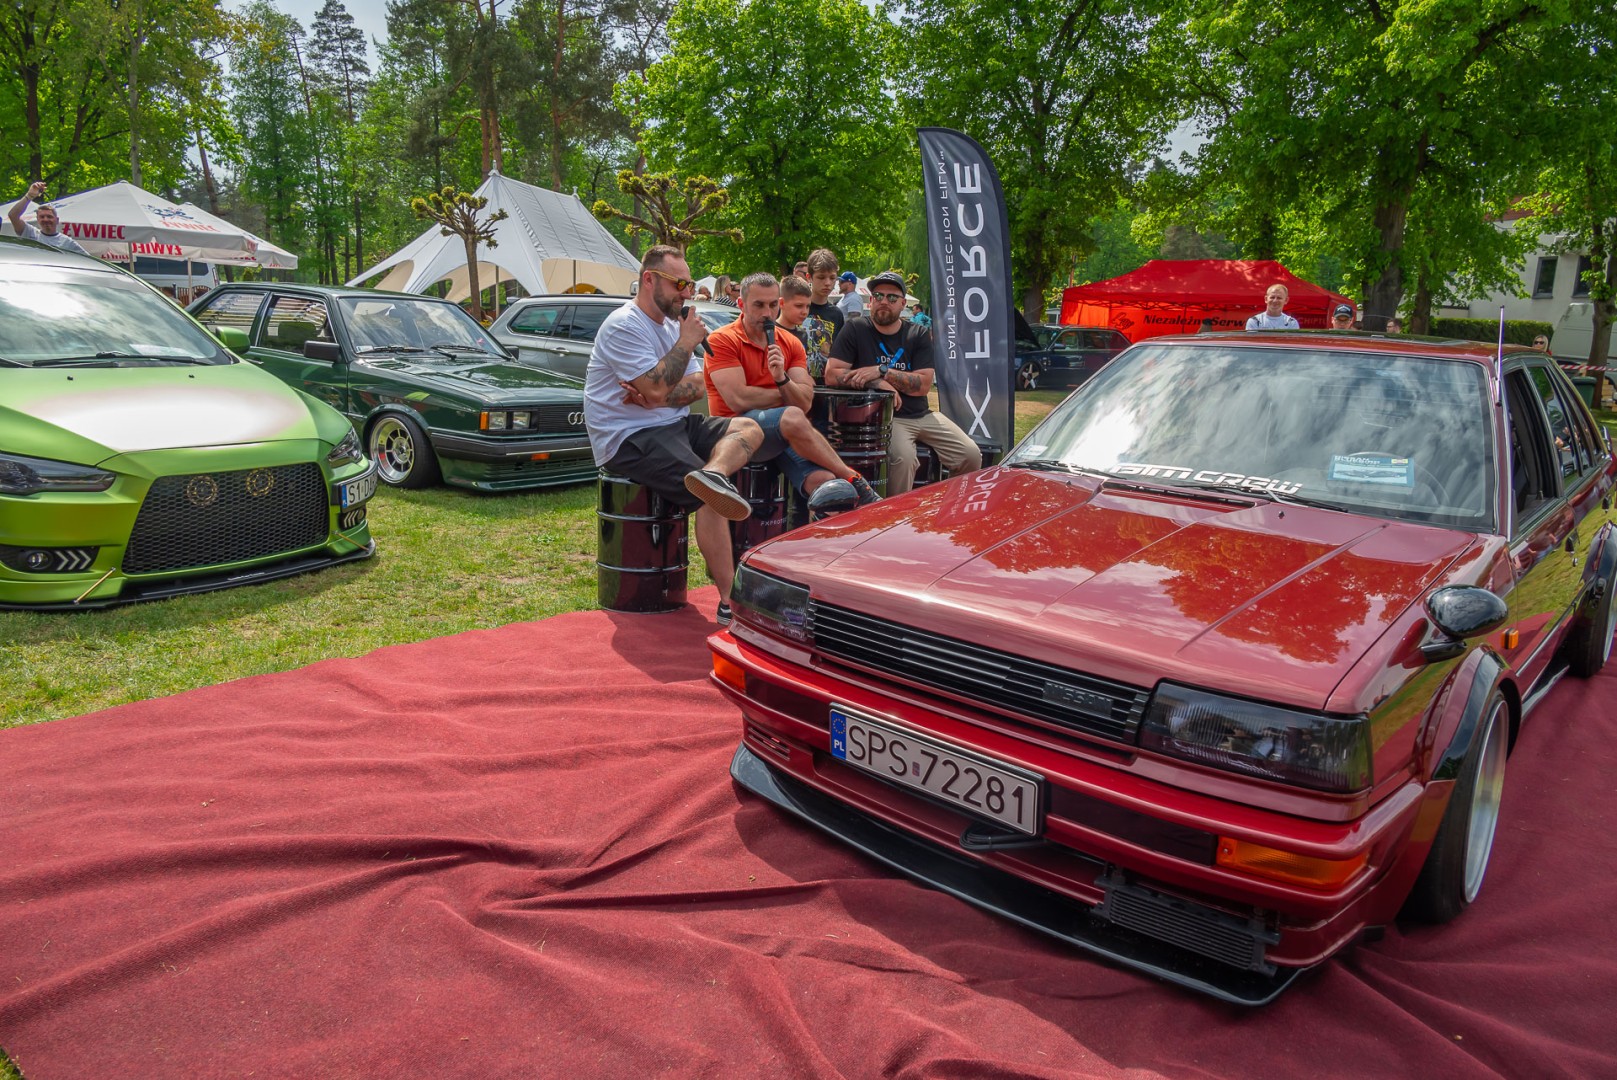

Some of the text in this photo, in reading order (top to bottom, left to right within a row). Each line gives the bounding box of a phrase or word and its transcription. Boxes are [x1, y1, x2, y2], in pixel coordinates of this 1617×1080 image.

[1143, 314, 1245, 327] Niezależn Serw
[834, 739, 845, 752] PL
[848, 724, 1024, 825] SPS 72281
